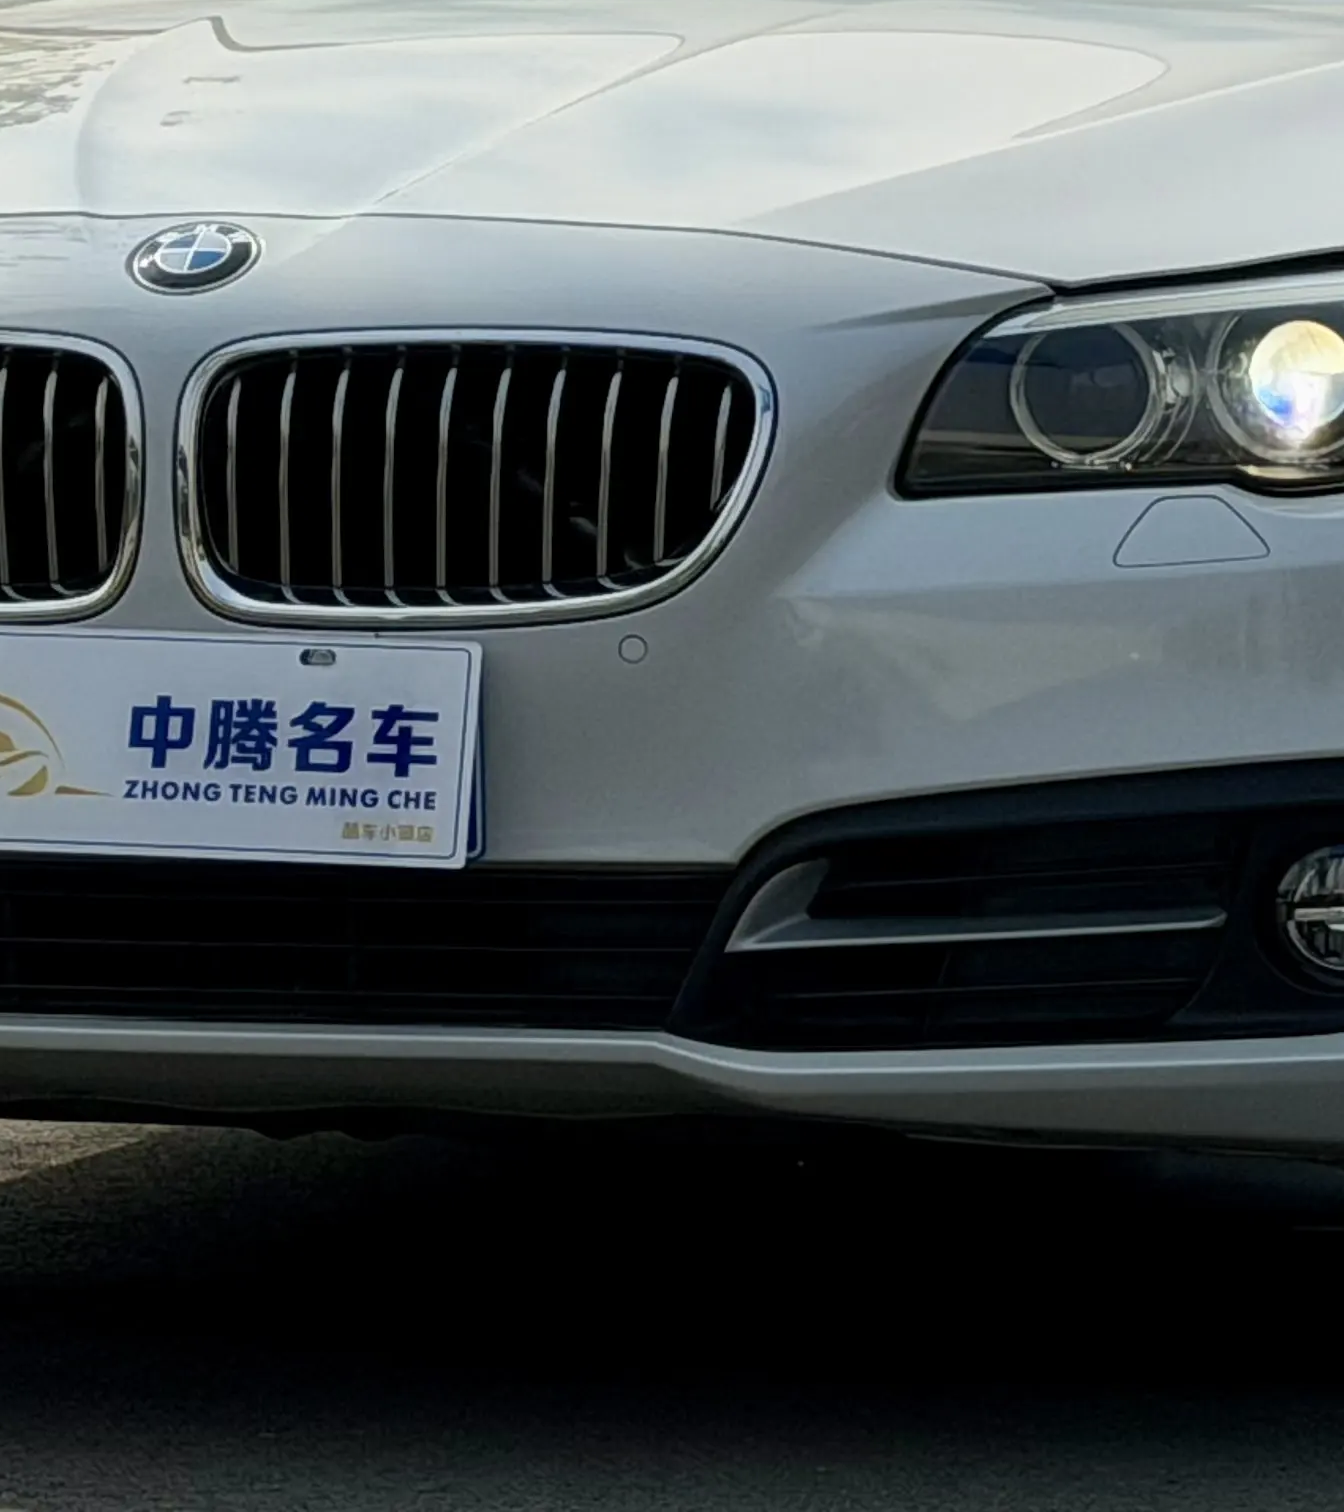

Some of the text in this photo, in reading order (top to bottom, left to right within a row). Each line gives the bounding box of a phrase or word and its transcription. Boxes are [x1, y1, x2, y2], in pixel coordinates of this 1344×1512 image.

[128, 695, 439, 778] 中腾名车
[123, 780, 437, 810] ZHONG TENG MING CHE
